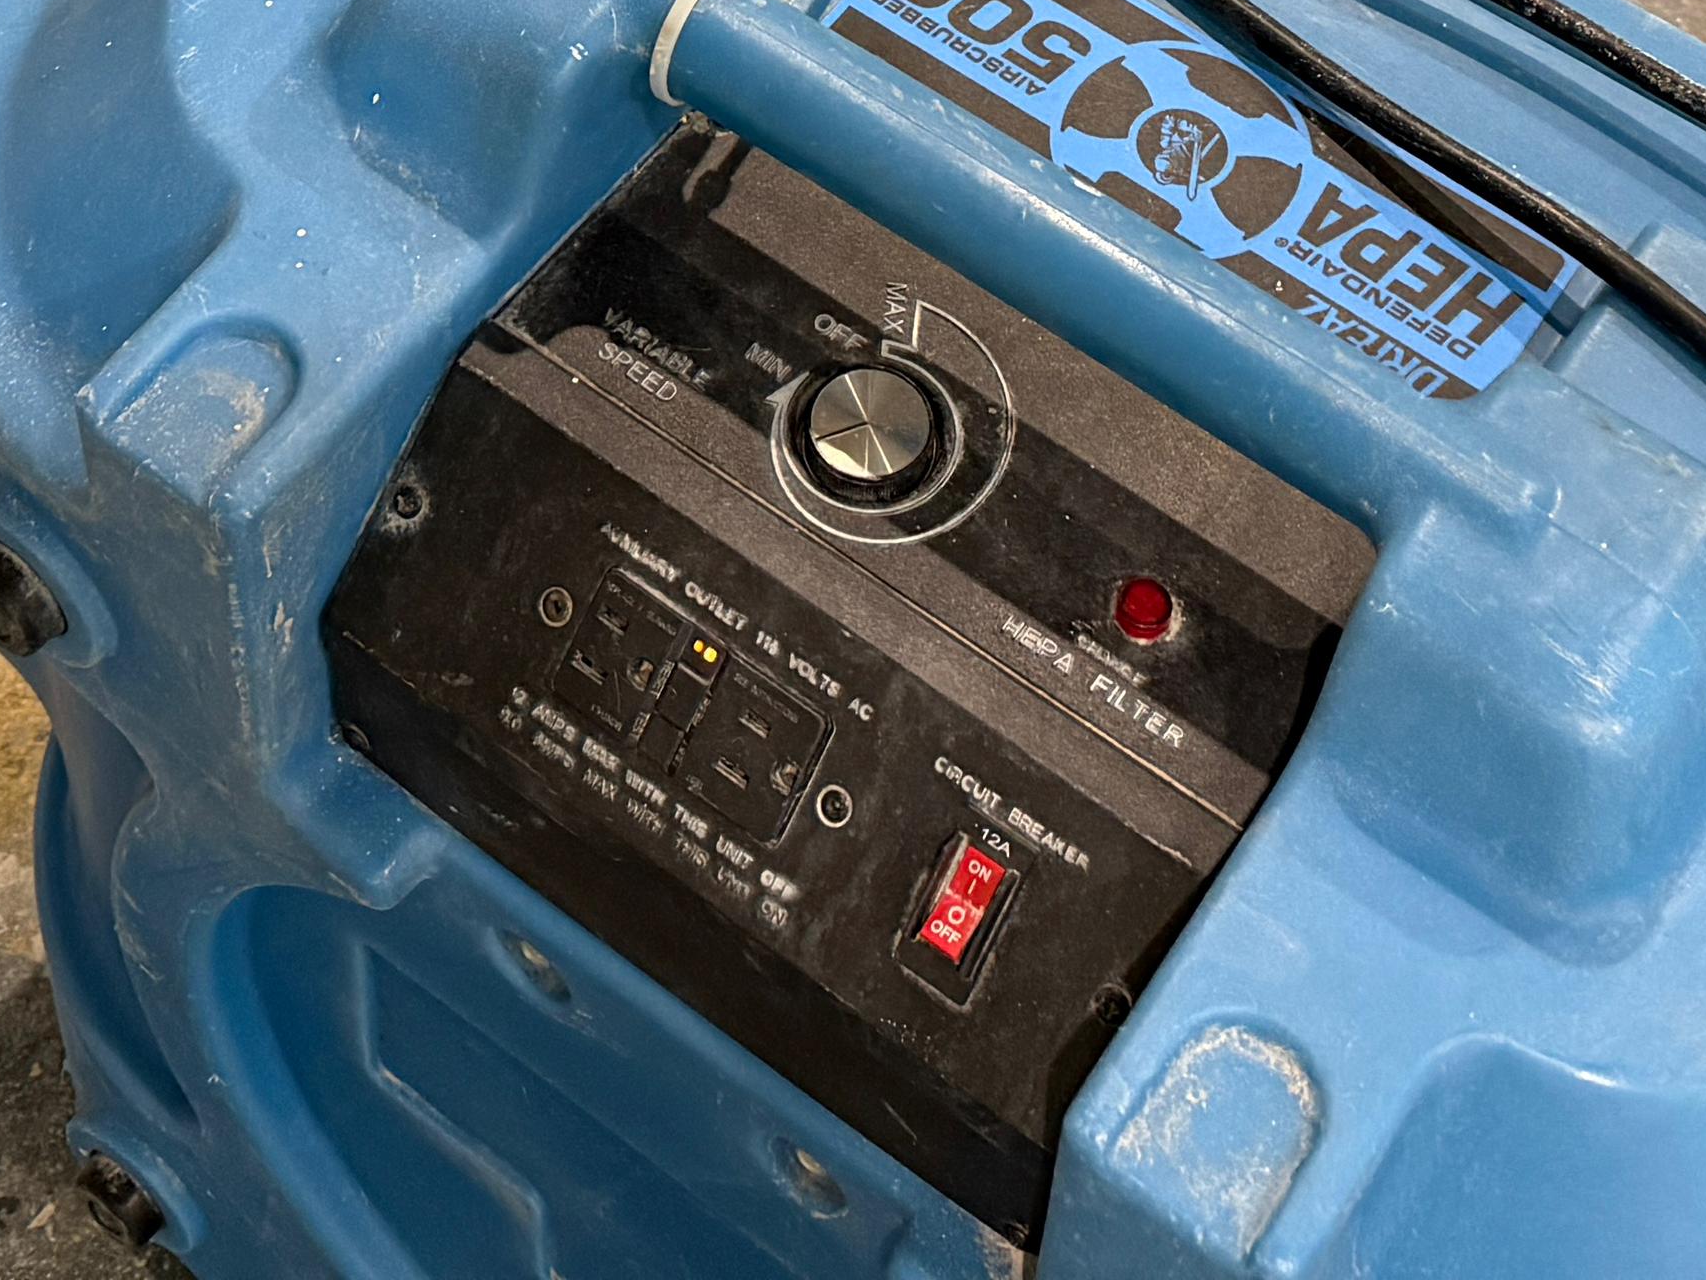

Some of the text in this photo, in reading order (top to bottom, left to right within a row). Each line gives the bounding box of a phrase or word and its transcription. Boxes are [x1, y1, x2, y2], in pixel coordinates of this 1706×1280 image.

[1297, 181, 1526, 346] HEPA
[814, 313, 868, 350] OFF
[882, 281, 908, 335] MAX
[598, 342, 677, 402] SPEED
[603, 307, 712, 392] VARIABLE
[744, 342, 793, 383] MIN
[684, 580, 749, 633] OUTLET
[788, 652, 842, 699] VOLTS
[847, 697, 875, 722] AC
[1001, 614, 1186, 748] HEPA FILTER
[531, 703, 580, 743] AMPS
[624, 768, 668, 807] WITH
[674, 803, 709, 839] THIS
[715, 835, 755, 869] UNIT
[760, 868, 800, 901] OFF
[934, 756, 1092, 875] CIRCUIT BREAKER
[582, 768, 619, 802] MAX
[626, 798, 667, 837] WITH
[674, 831, 711, 868] THIS
[759, 898, 789, 927] ON
[968, 859, 992, 883] ON
[980, 827, 1012, 858] 12A
[930, 919, 963, 945] OFF
